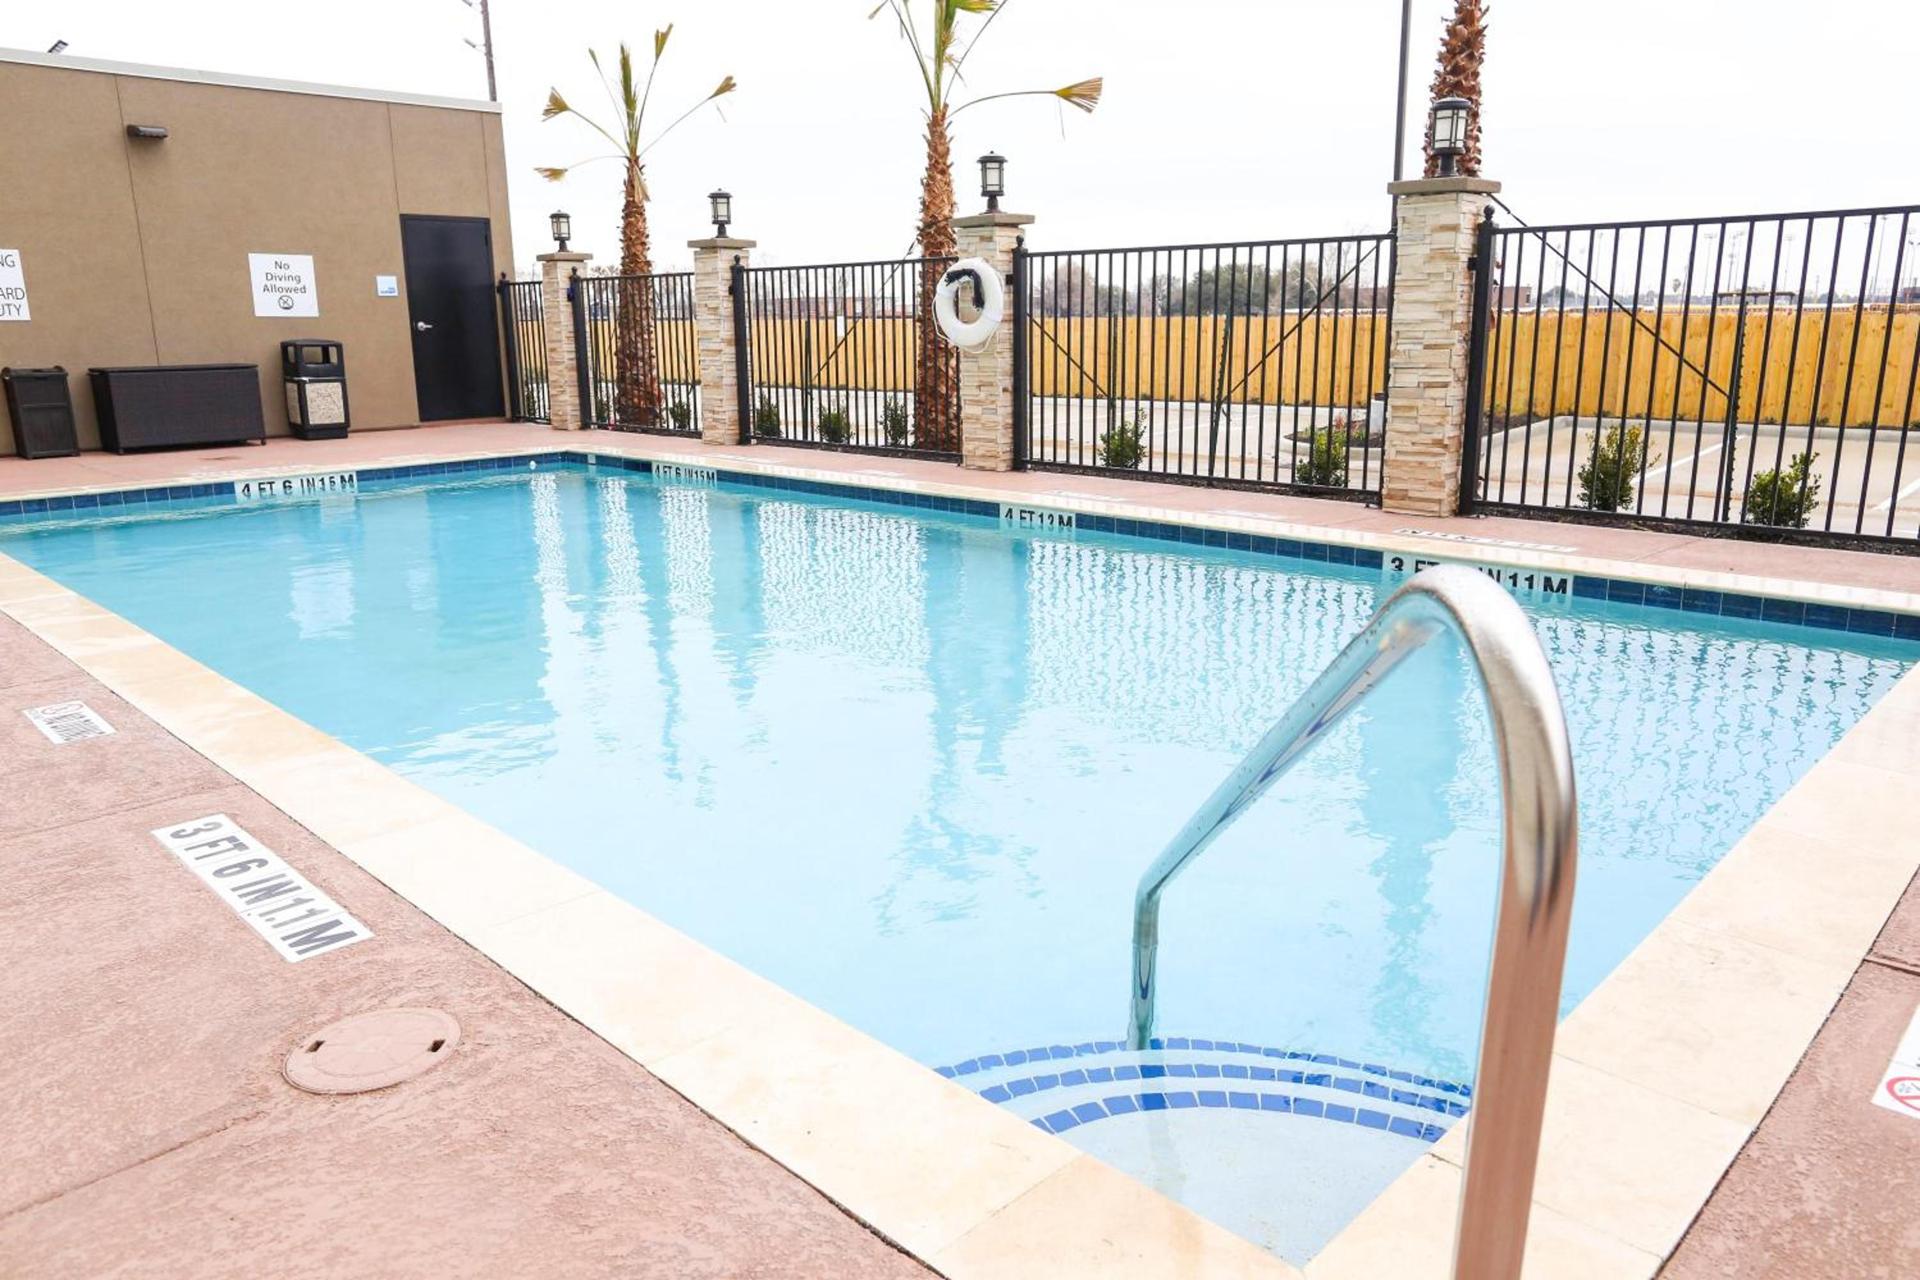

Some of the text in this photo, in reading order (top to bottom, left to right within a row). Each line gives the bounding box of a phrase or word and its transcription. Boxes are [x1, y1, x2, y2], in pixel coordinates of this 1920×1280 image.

[274, 260, 290, 270] No
[265, 272, 302, 285] Diving
[263, 283, 307, 294] Allowed
[242, 483, 251, 496] 4
[258, 481, 276, 496] FT
[283, 480, 293, 494] 6
[1020, 509, 1036, 523] FT
[1391, 556, 1405, 573] 3
[169, 820, 223, 840] 3
[184, 835, 250, 861] FT
[212, 857, 269, 879] 6
